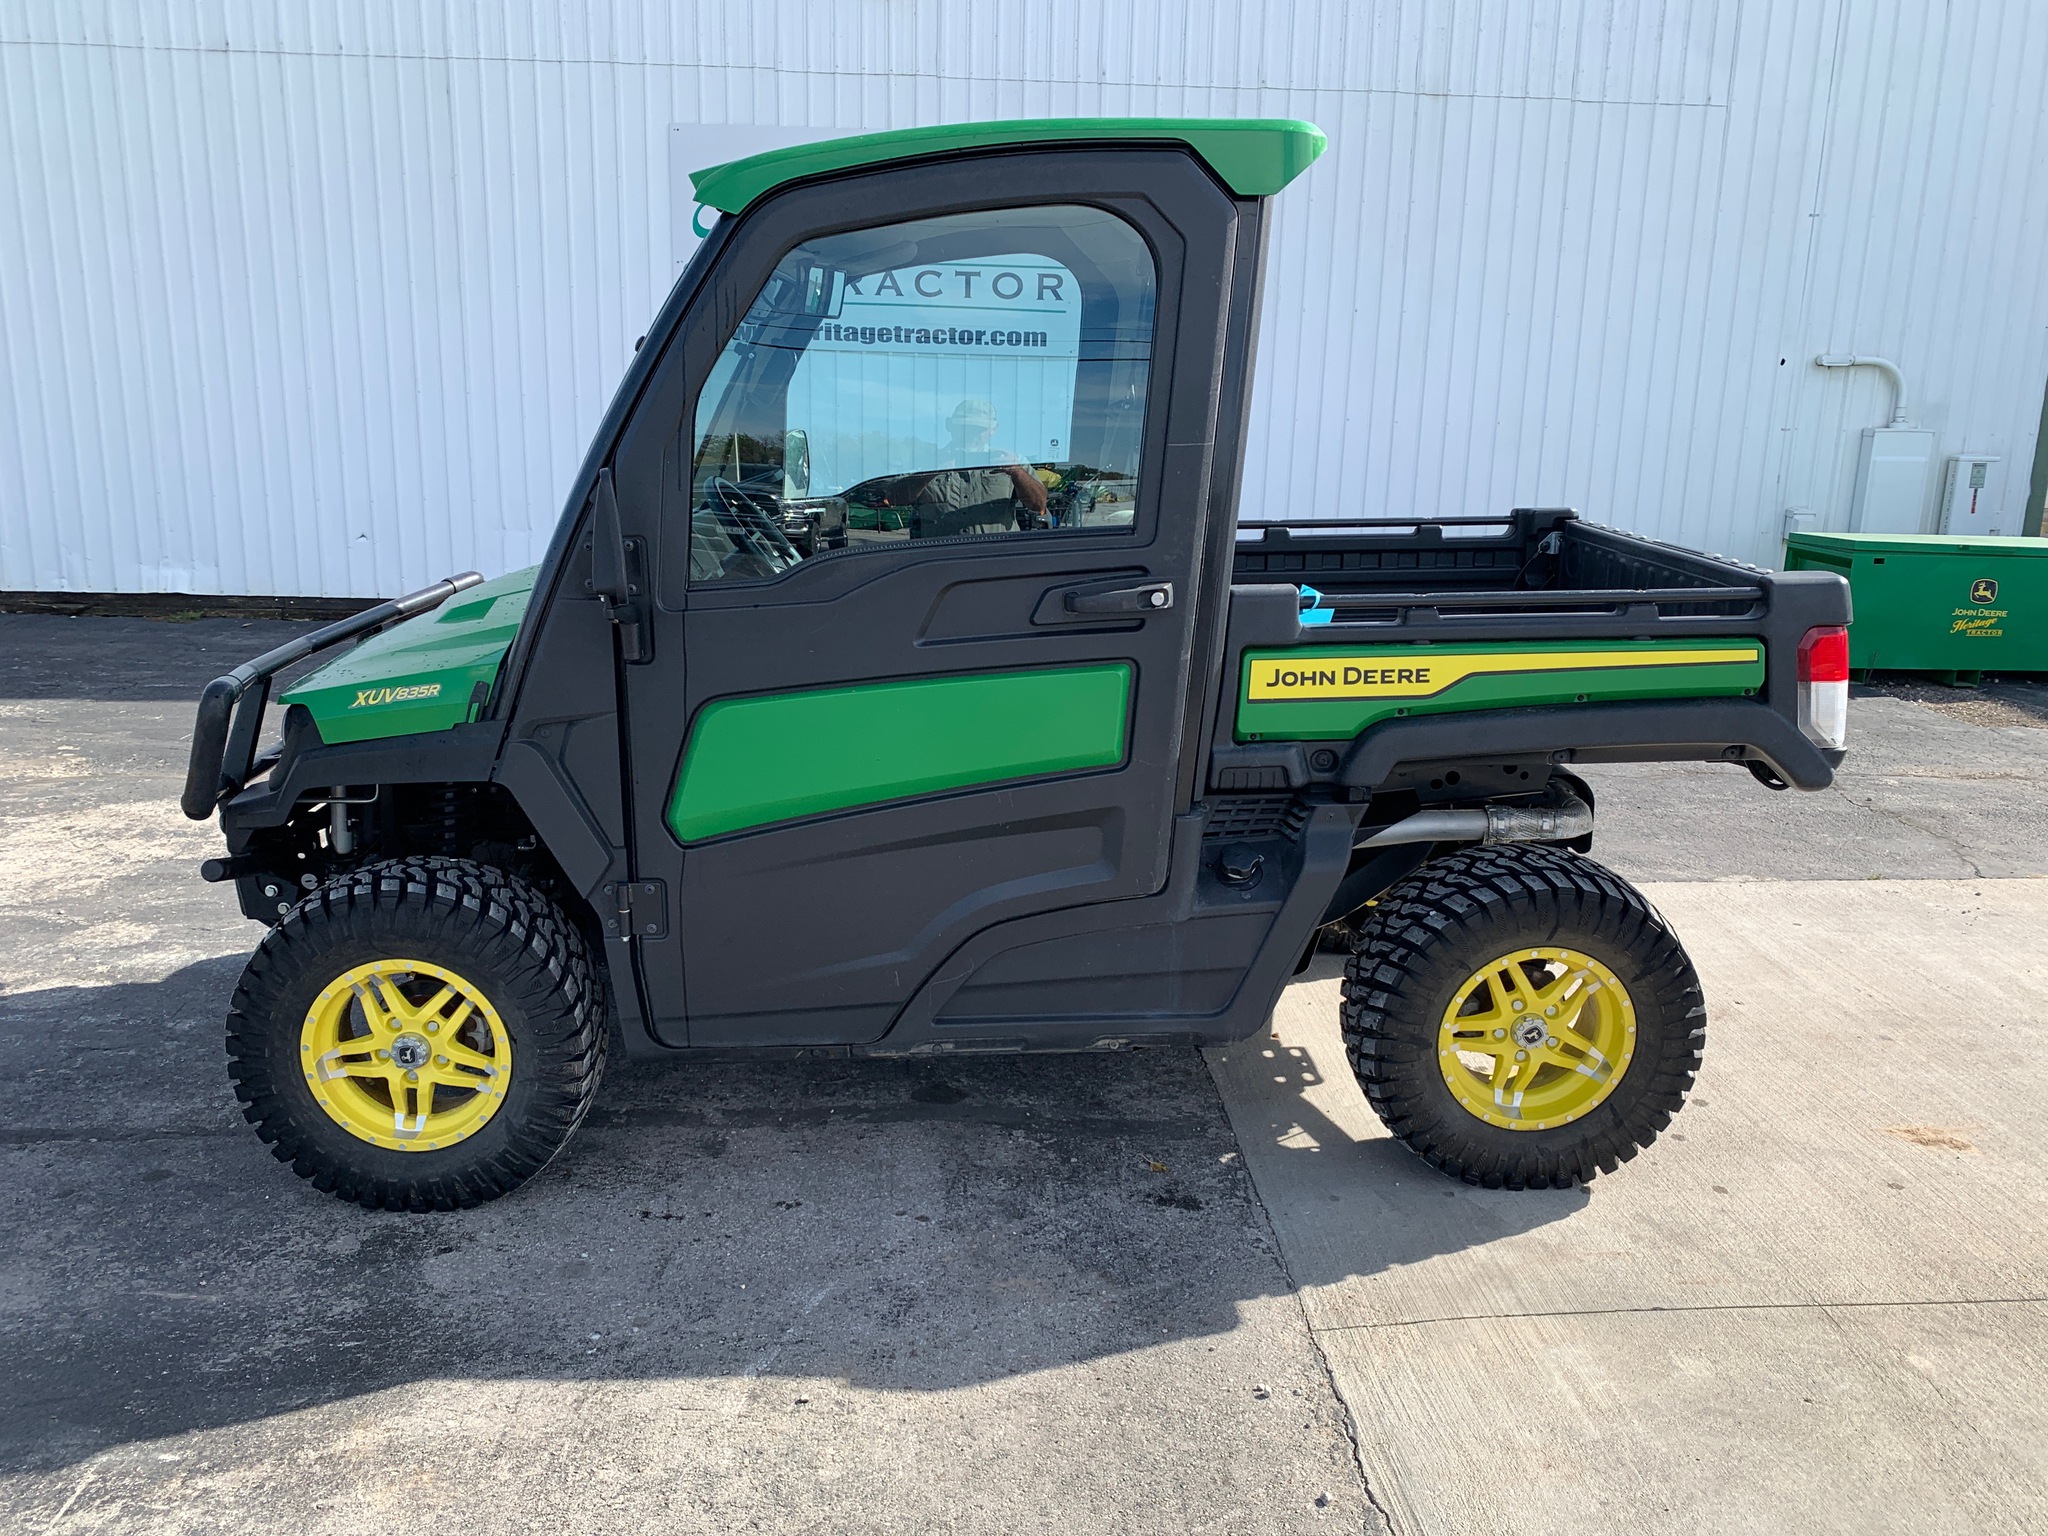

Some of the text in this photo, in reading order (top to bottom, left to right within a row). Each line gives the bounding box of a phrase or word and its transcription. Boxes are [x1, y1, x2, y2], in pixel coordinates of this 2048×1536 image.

[1951, 607, 2008, 618] JOHN DEERE
[1966, 629, 2003, 637] TRACTOR
[1266, 666, 1431, 688] JOHN DEERE
[350, 684, 441, 708] XUV835R
